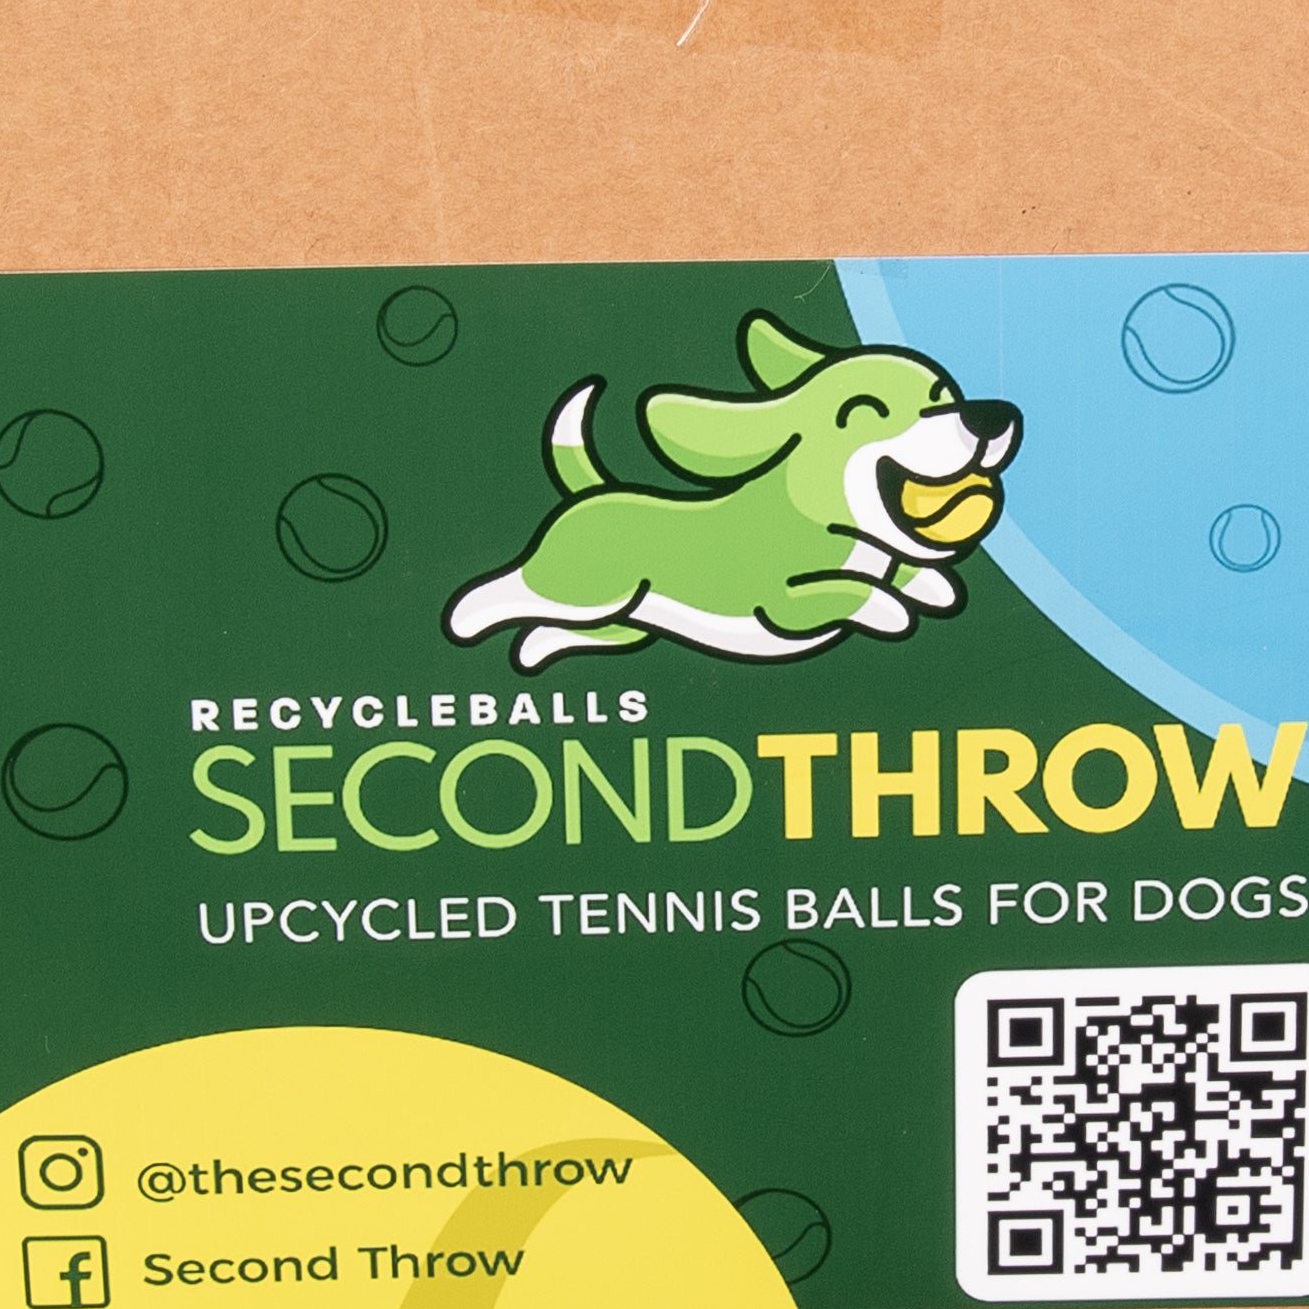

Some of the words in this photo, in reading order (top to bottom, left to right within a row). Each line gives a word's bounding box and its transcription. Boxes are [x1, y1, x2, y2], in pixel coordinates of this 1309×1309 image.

[190, 689, 648, 732] RECYCLEBALLS
[198, 896, 517, 945] UPCYCLED
[538, 888, 761, 936] TENNIS
[786, 883, 963, 930] BALLS
[989, 880, 1108, 925] FOR
[1133, 874, 1309, 922] DOGS
[137, 1151, 633, 1203] @thesecondthrow
[143, 1246, 339, 1286] Second
[357, 1244, 525, 1280] Throw
